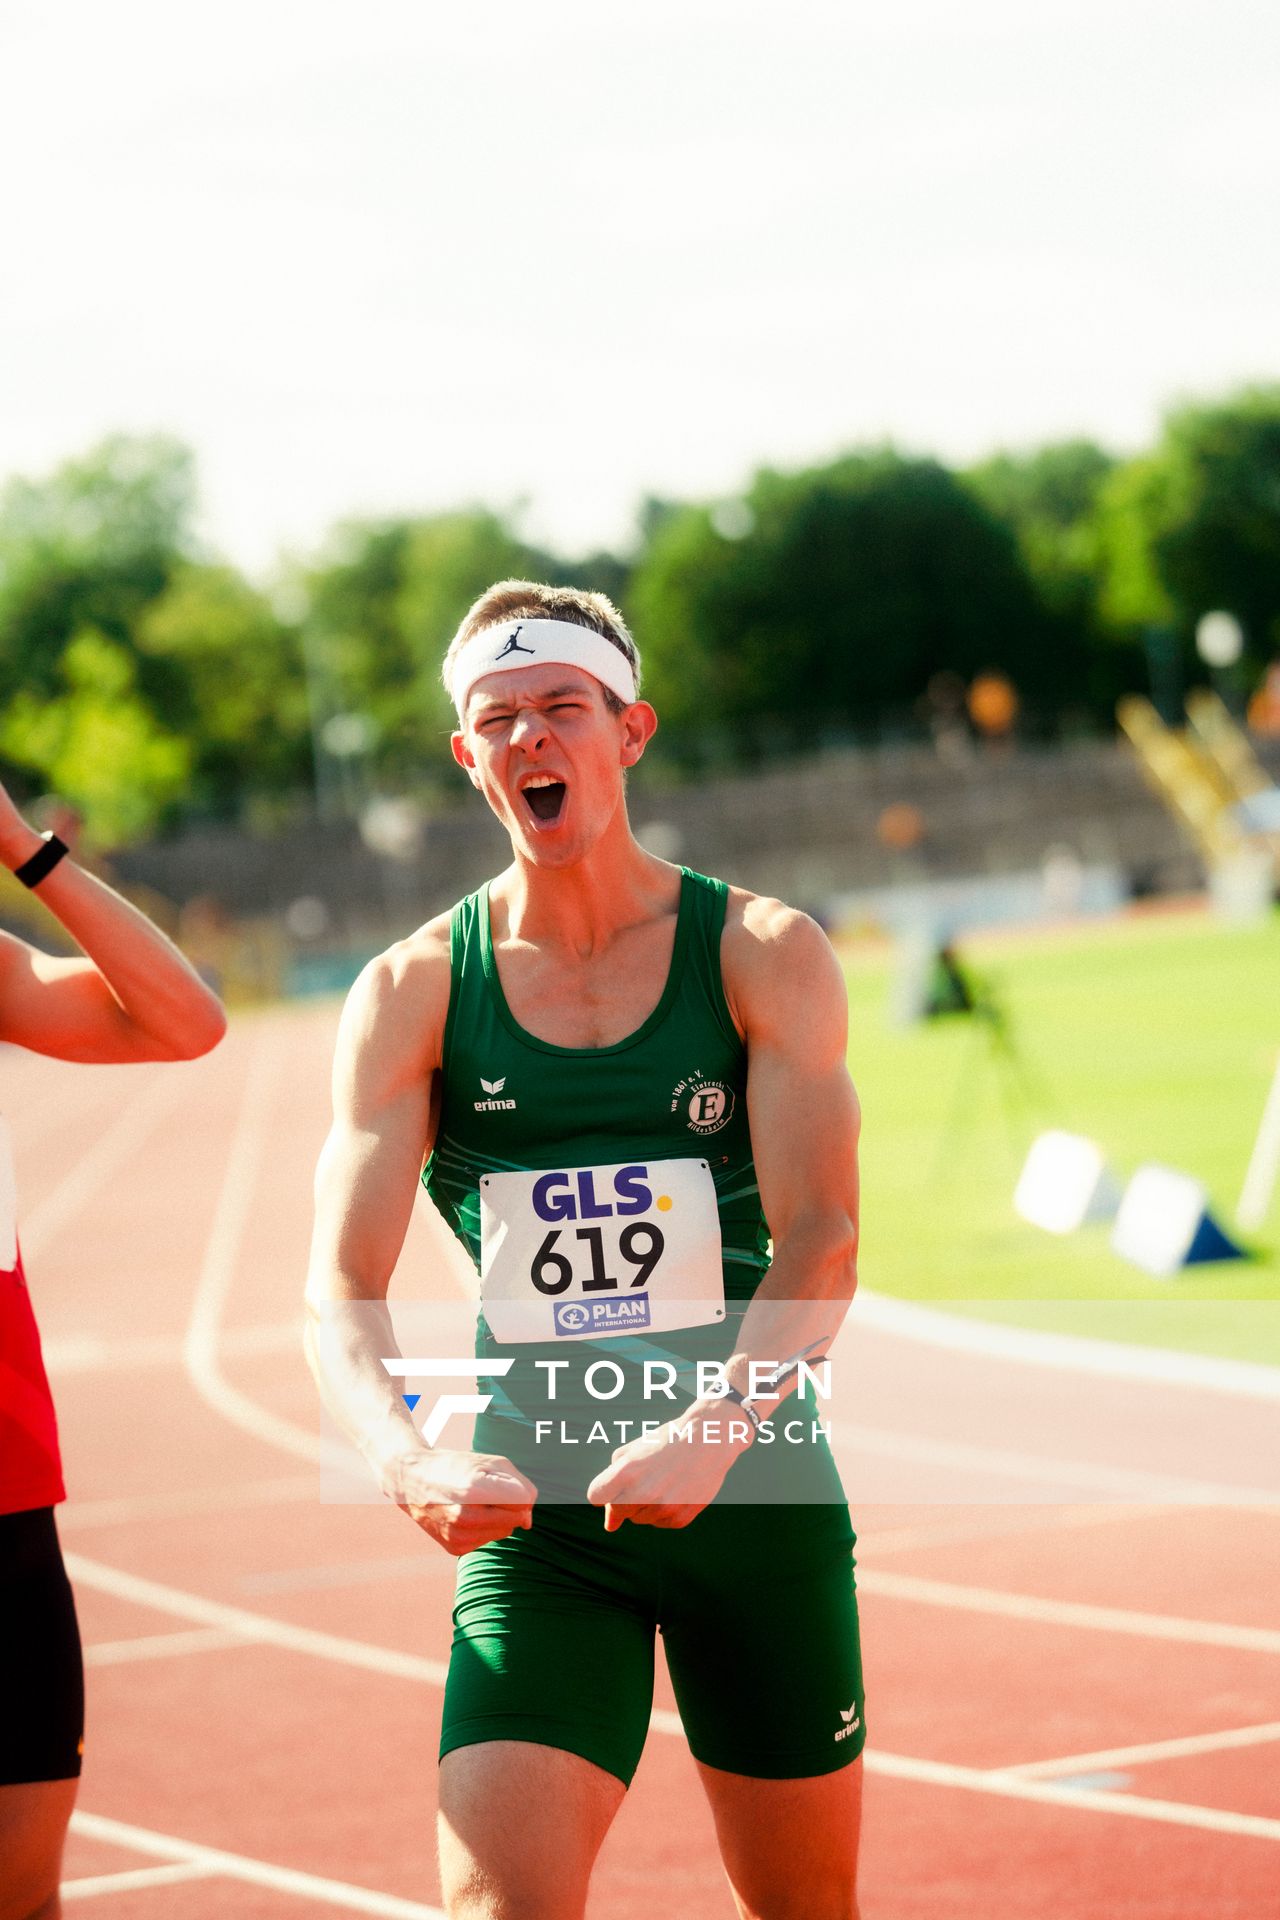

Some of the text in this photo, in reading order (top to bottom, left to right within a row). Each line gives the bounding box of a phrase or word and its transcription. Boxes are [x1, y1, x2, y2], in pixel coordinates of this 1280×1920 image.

[672, 1080, 688, 1097] 1861
[690, 1081, 725, 1093] Eintracht
[474, 1098, 516, 1111] erima
[696, 1092, 719, 1122] E
[530, 1221, 665, 1296] 619
[592, 1300, 646, 1320] PLAN
[594, 1318, 647, 1328] INTERNATIONAL
